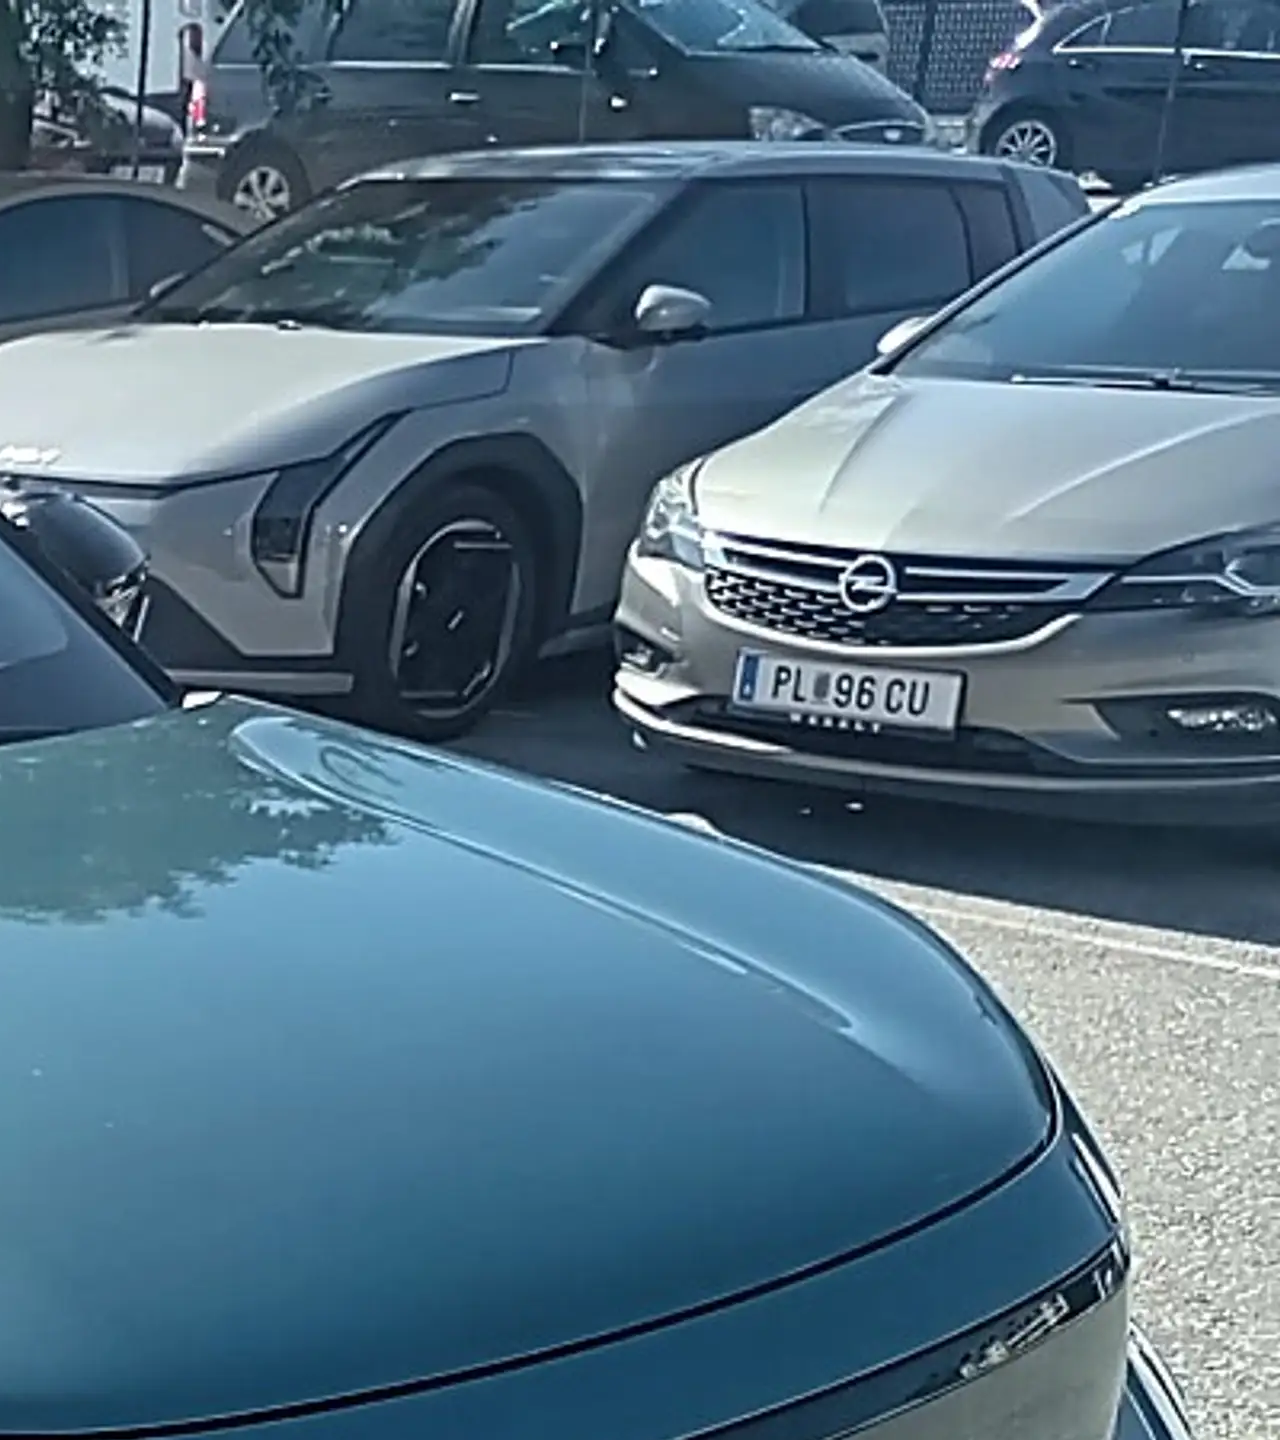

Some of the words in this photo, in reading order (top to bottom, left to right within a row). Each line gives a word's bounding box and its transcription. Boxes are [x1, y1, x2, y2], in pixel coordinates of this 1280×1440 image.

[771, 665, 806, 702] PL
[833, 673, 876, 710] 96
[885, 678, 930, 717] CU
